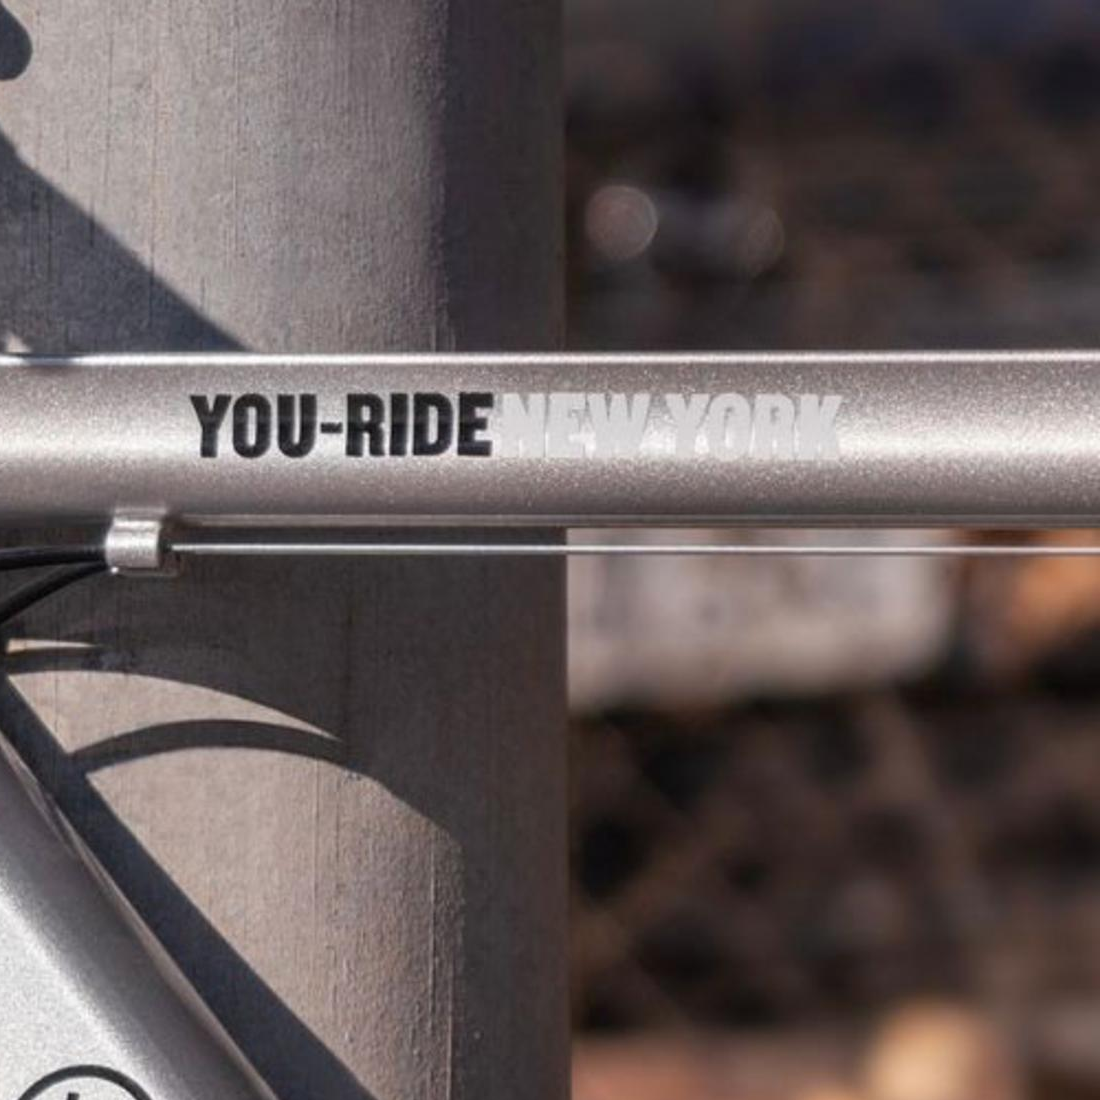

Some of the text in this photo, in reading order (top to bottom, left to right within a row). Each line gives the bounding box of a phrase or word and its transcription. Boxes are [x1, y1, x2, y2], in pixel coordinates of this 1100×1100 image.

[189, 391, 842, 461] YOU-RIDE NEW YORK
